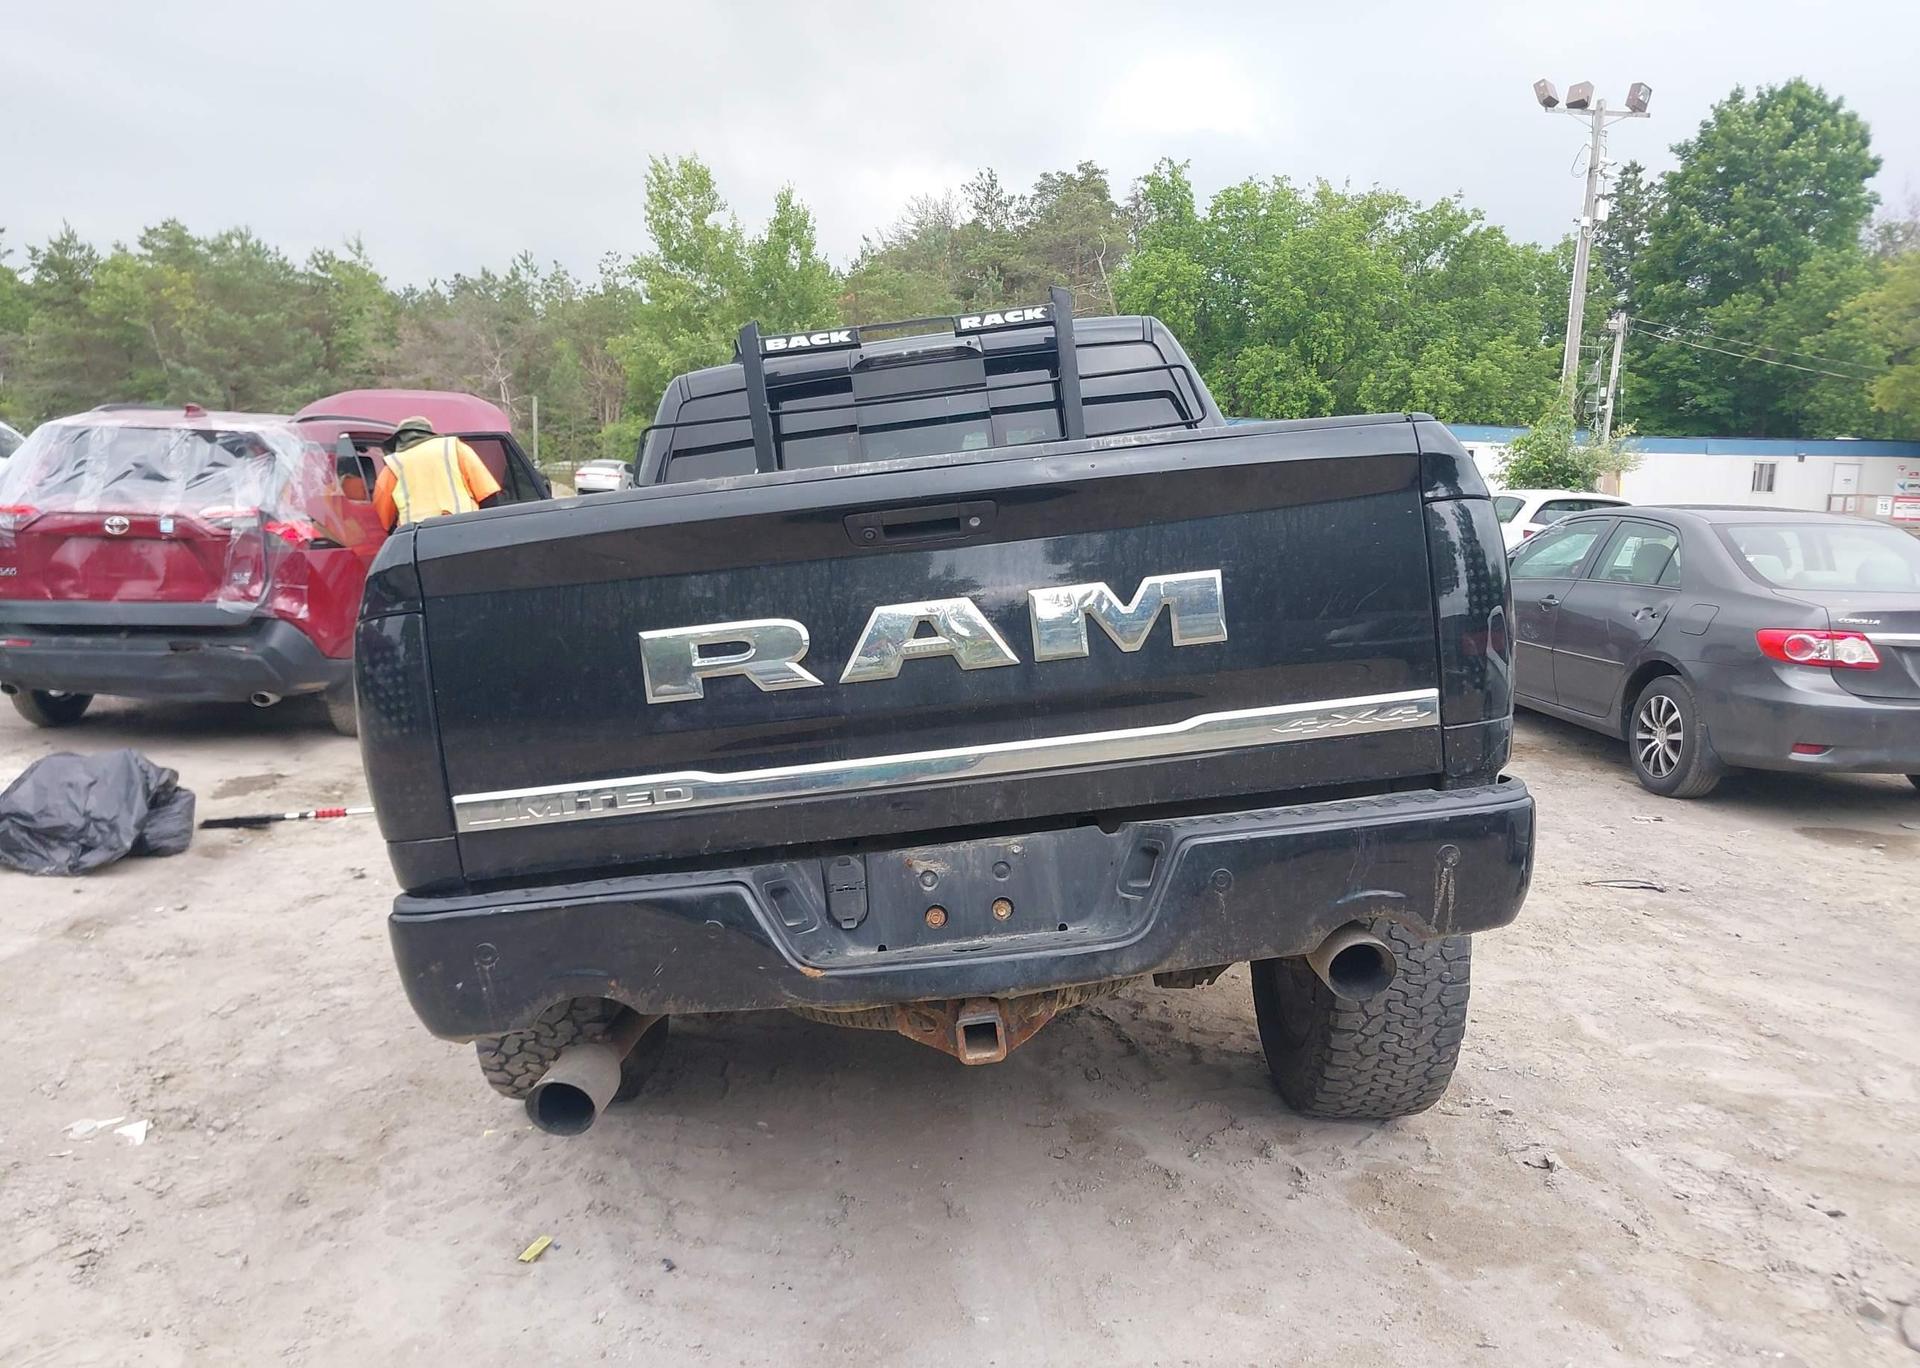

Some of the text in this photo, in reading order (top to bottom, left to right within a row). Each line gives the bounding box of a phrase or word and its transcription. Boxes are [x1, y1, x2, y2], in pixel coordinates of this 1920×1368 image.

[765, 307, 1047, 351] BACK RACK
[638, 569, 1228, 704] RAM
